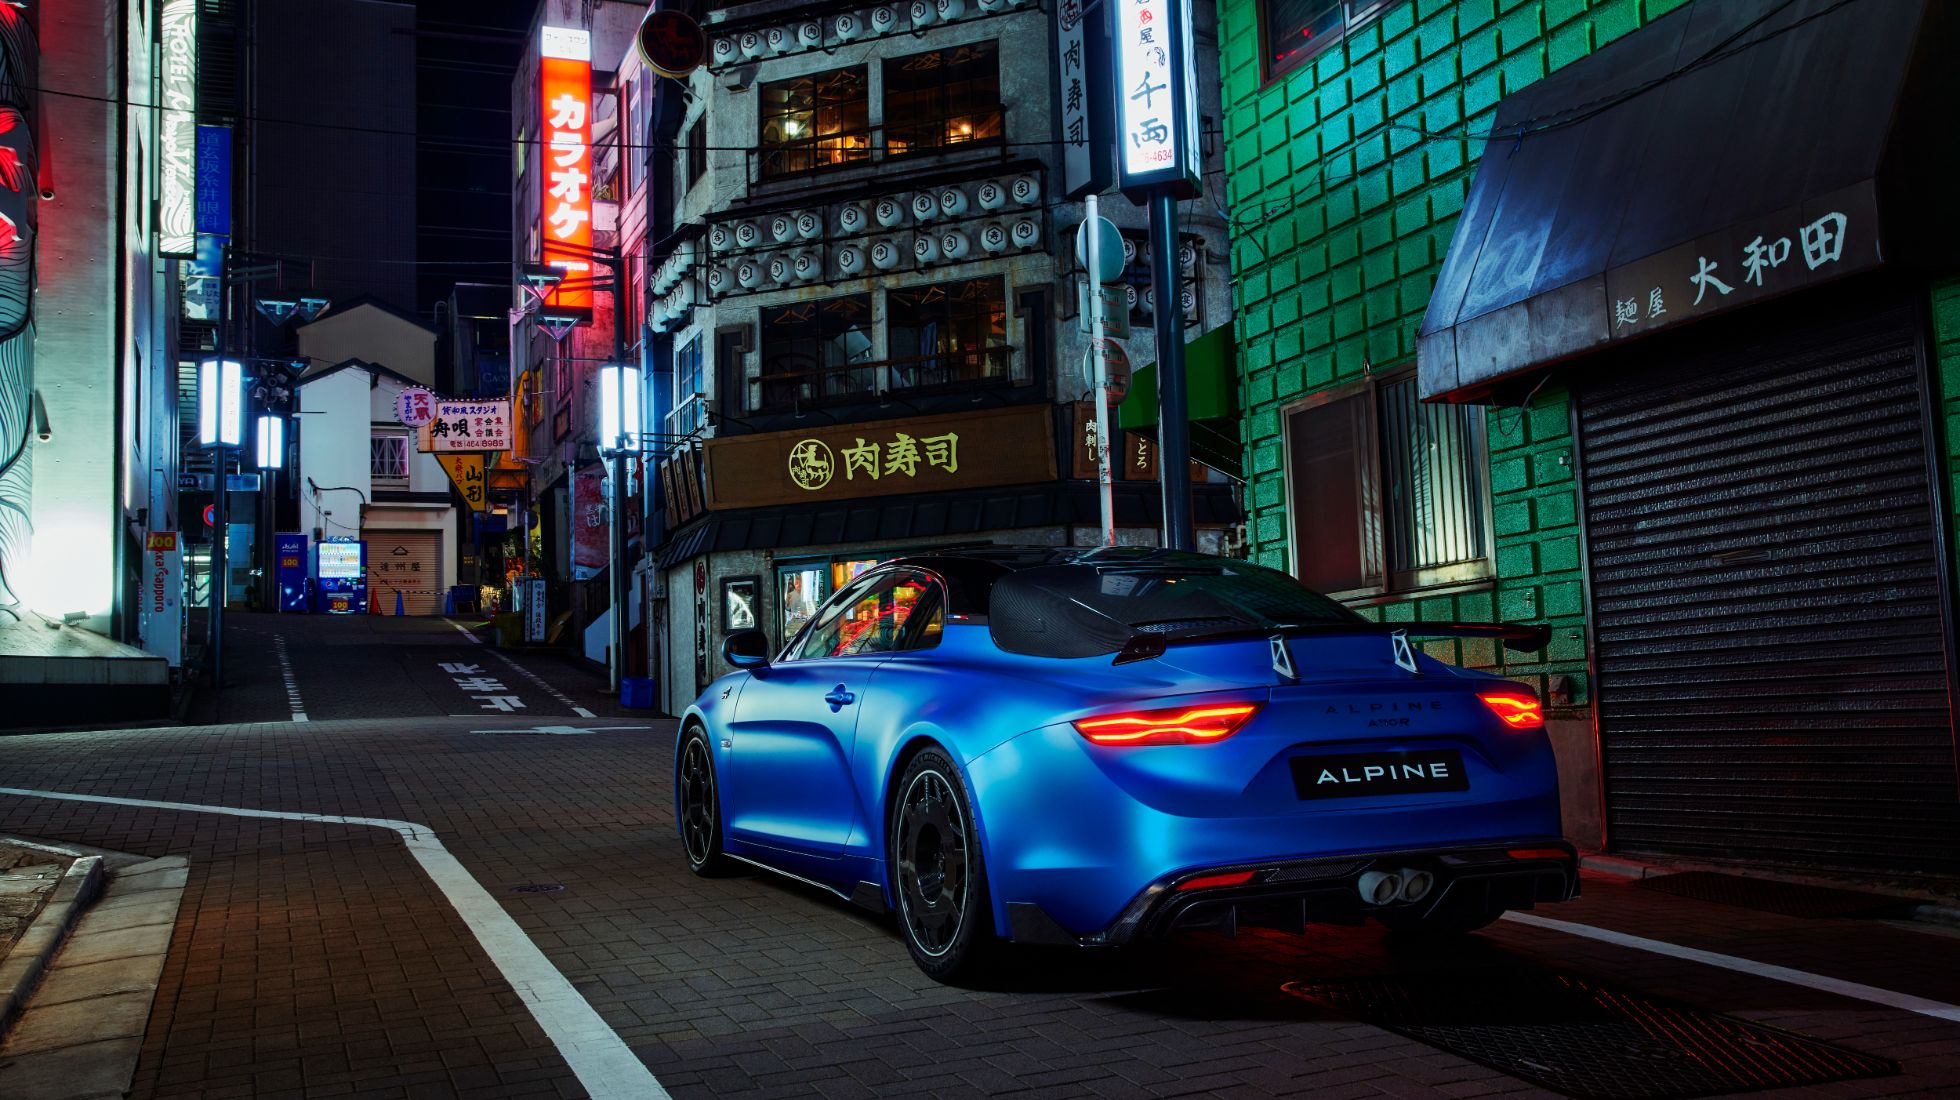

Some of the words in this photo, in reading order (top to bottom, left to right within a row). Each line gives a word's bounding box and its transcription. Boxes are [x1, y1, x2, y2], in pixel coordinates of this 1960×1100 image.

[169, 22, 189, 84] HOTEL
[1064, 38, 1084, 150] 肉寿司
[198, 132, 221, 229] 道玄坂糸井眼科
[549, 94, 589, 240] カラオケ
[1689, 211, 1848, 307] 大和田
[404, 395, 413, 422] やまがた
[430, 417, 471, 438] 舟唄
[482, 439, 504, 448] 8989
[1084, 419, 1098, 462] 肉刺し
[840, 431, 960, 482] 肉寿司
[1136, 437, 1147, 469] とろ
[466, 464, 483, 502] 山形
[147, 536, 174, 548] 100
[282, 558, 298, 567] 100
[332, 601, 348, 610] 100
[1325, 700, 1443, 715] ALPINE
[1316, 762, 1449, 785] ALPINE
